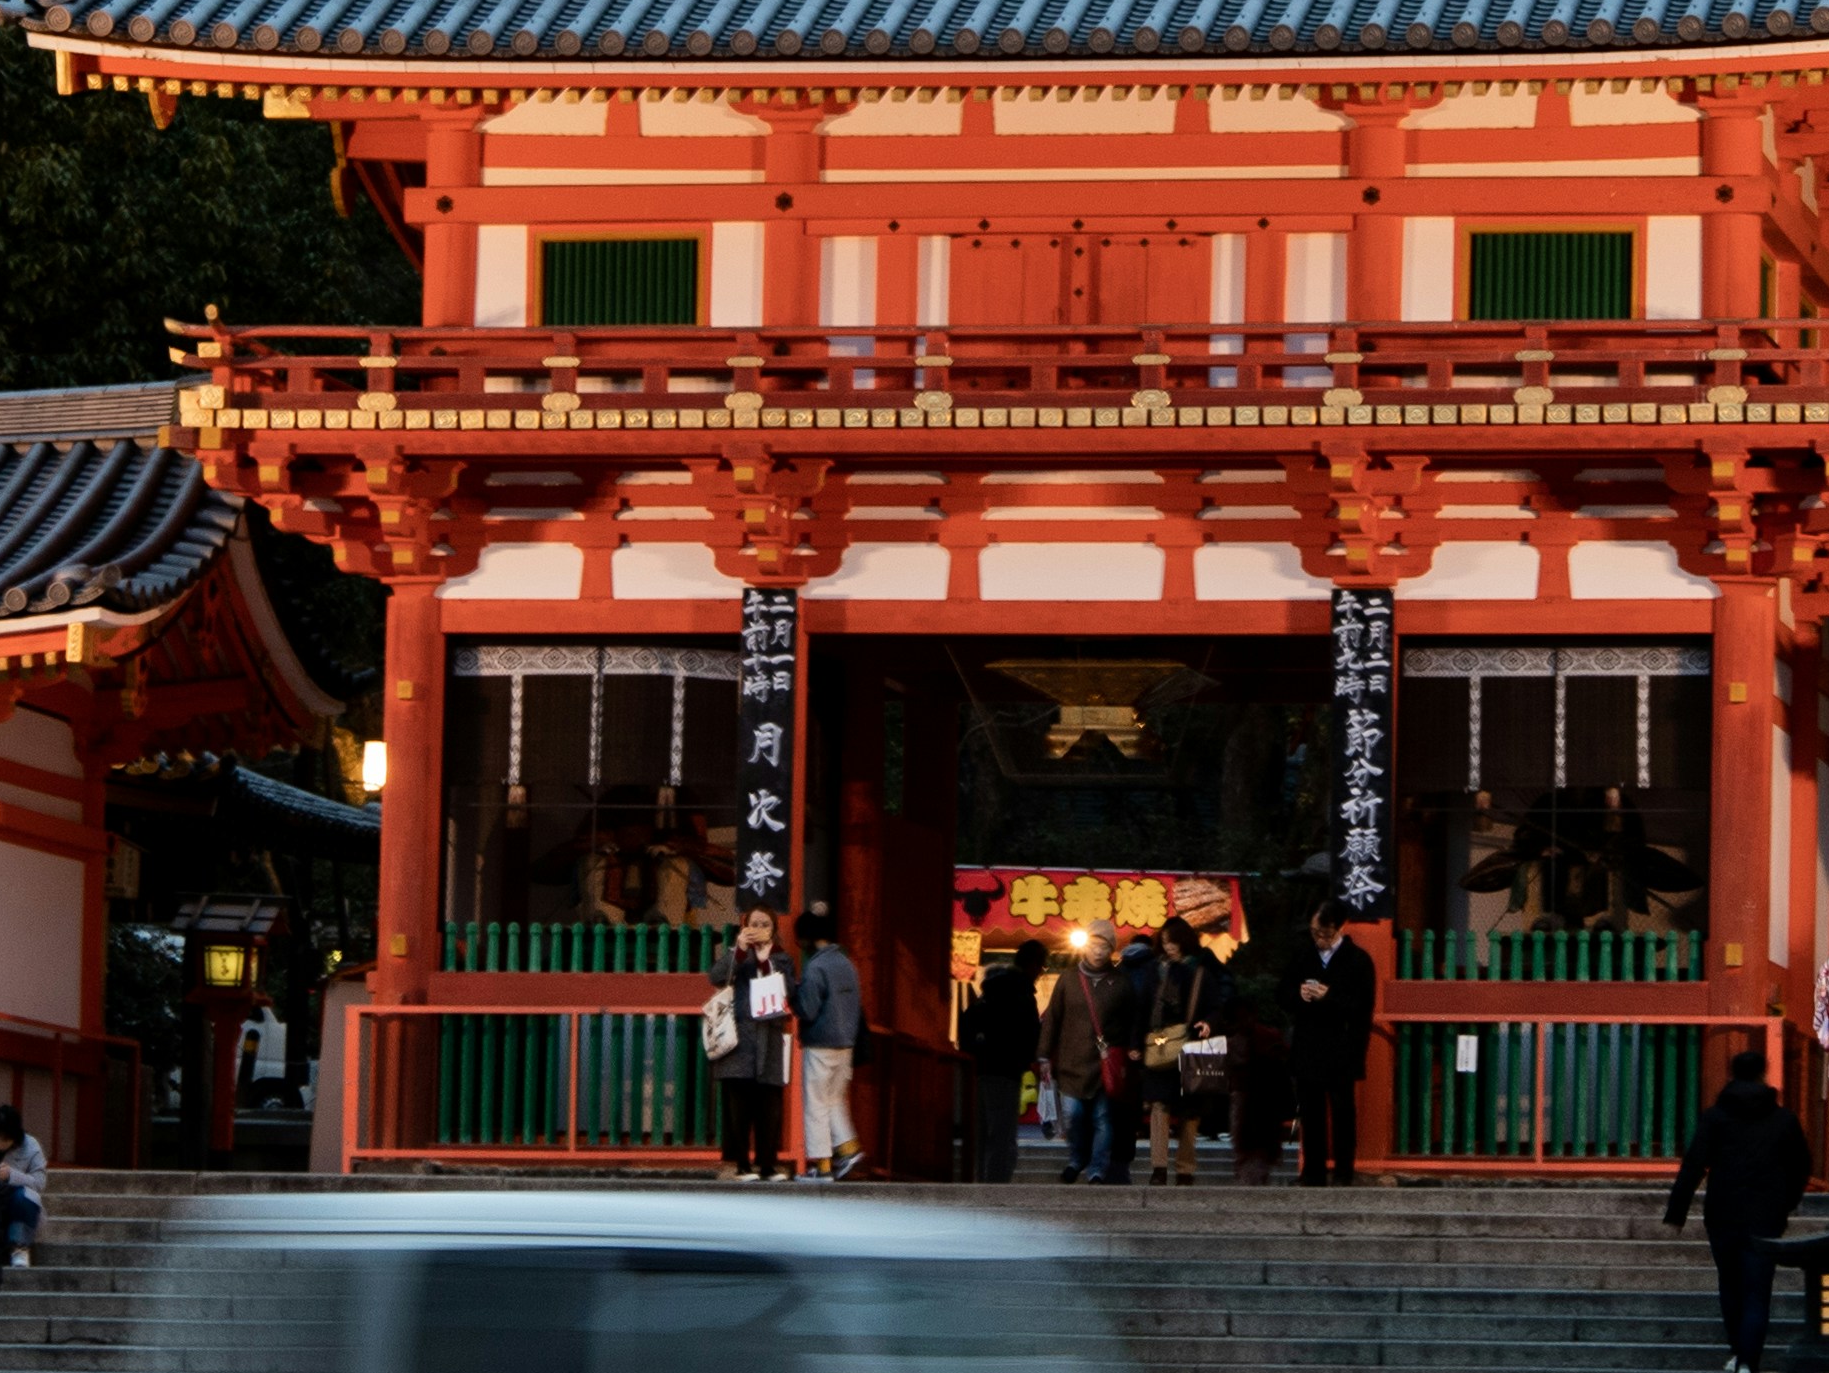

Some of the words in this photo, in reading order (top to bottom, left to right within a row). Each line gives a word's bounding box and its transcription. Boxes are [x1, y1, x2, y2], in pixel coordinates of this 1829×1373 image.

[741, 590, 771, 703] 午前十時
[769, 595, 796, 691] 二月一日
[1333, 590, 1365, 705] 午前九時
[1363, 598, 1391, 694] 二月二日
[739, 722, 786, 897] 月次祭
[1338, 707, 1386, 911] 節分祈願祭
[1010, 874, 1166, 929] 牛串焼
